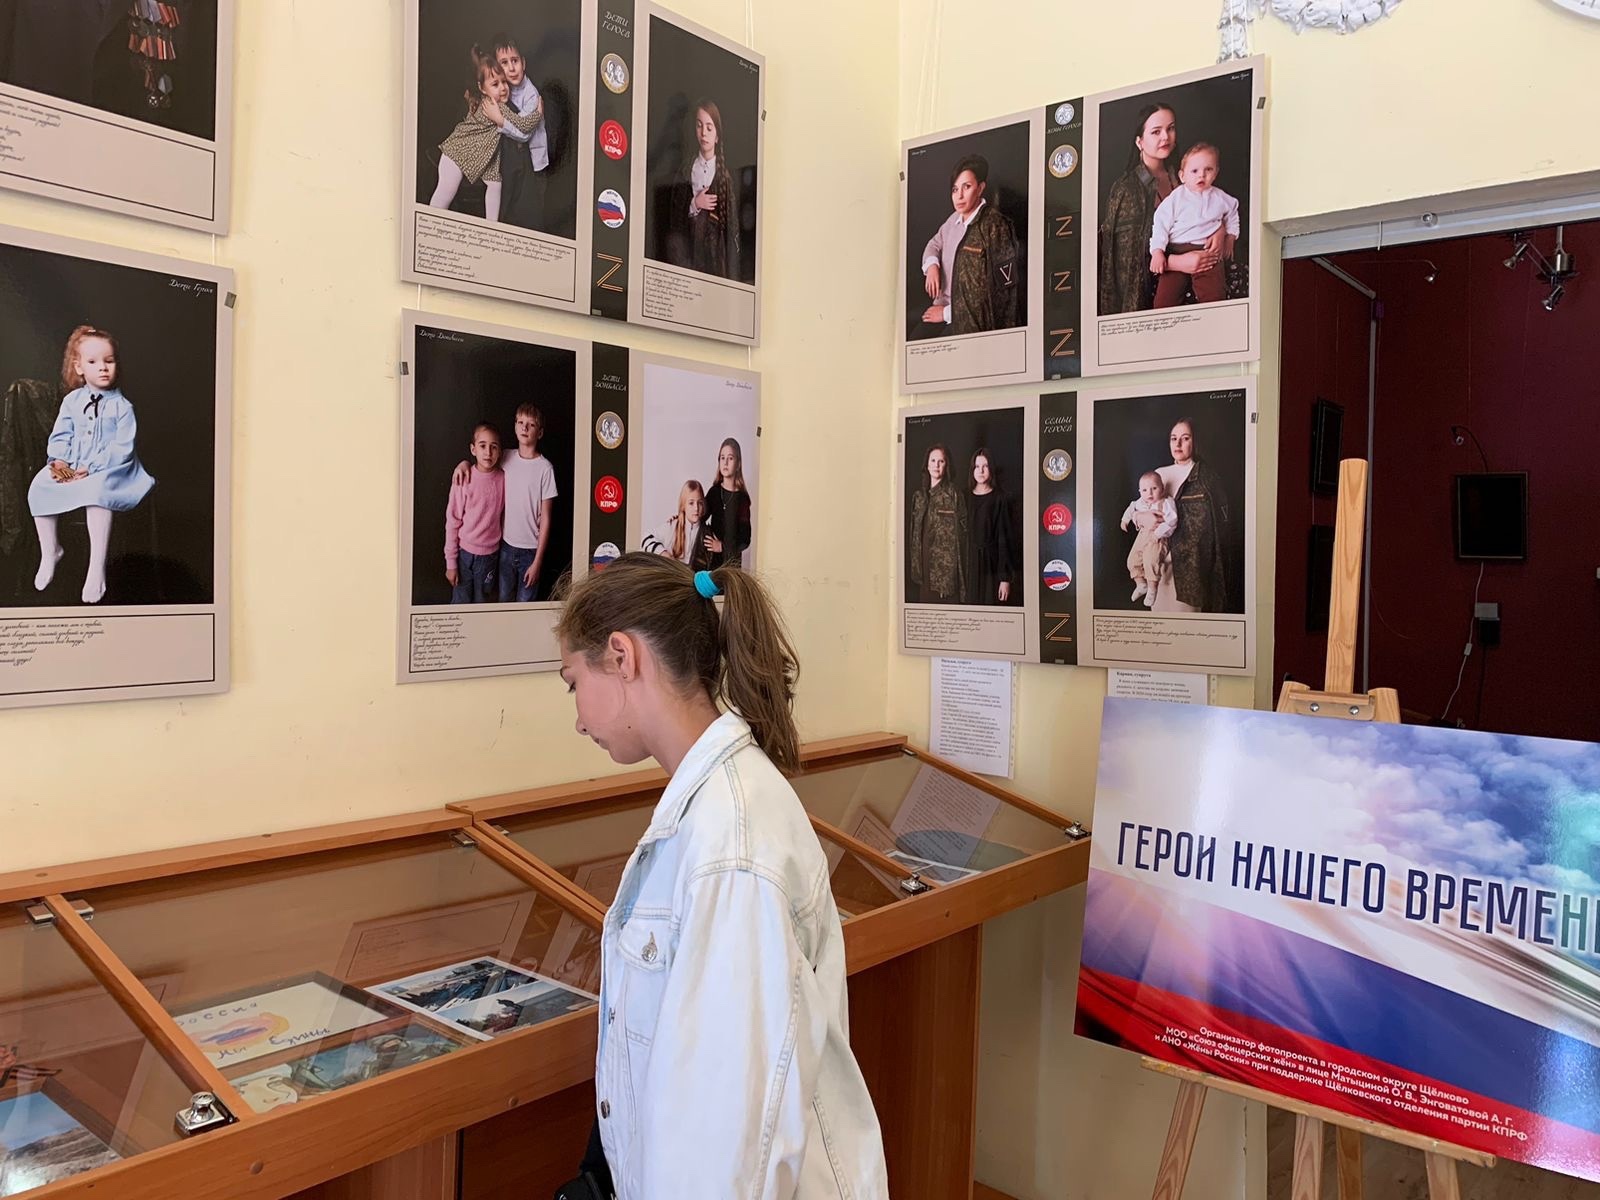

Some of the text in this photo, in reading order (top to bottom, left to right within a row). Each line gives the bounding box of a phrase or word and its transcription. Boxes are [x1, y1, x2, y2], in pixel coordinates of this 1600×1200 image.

[601, 21, 631, 39] ГЕРОЕВ
[604, 144, 622, 156] КПРФ
[595, 381, 627, 392] ДОНБАССА
[1044, 416, 1072, 426] СЕМЬИ
[1043, 424, 1073, 434] ГЕРОЕВ
[600, 500, 618, 508] КПРФ
[1117, 822, 1600, 955] ГЕРОИ НАШЕГО ВРЕМЕН
[1199, 1026, 1257, 1049] Организатор
[1257, 1042, 1319, 1066] фотопроекта
[1327, 1062, 1381, 1082] городском
[1382, 1077, 1418, 1093] округе
[1419, 1085, 1469, 1106] Щёлково
[1165, 1026, 1515, 1128] МОО «Союз офицерских жён» в лице Матыциной О. В., Энговатовой А. Г.
[1161, 1034, 1182, 1047] АНО
[1182, 1041, 1213, 1057] «Жёны
[1213, 1049, 1250, 1066] России»
[1251, 1061, 1269, 1073] при
[1269, 1066, 1324, 1087] поддержке
[1325, 1079, 1392, 1106] Щёлковского
[1393, 1100, 1449, 1121] отделения
[1450, 1113, 1490, 1132] партии
[1491, 1125, 1529, 1142] КПРФ
